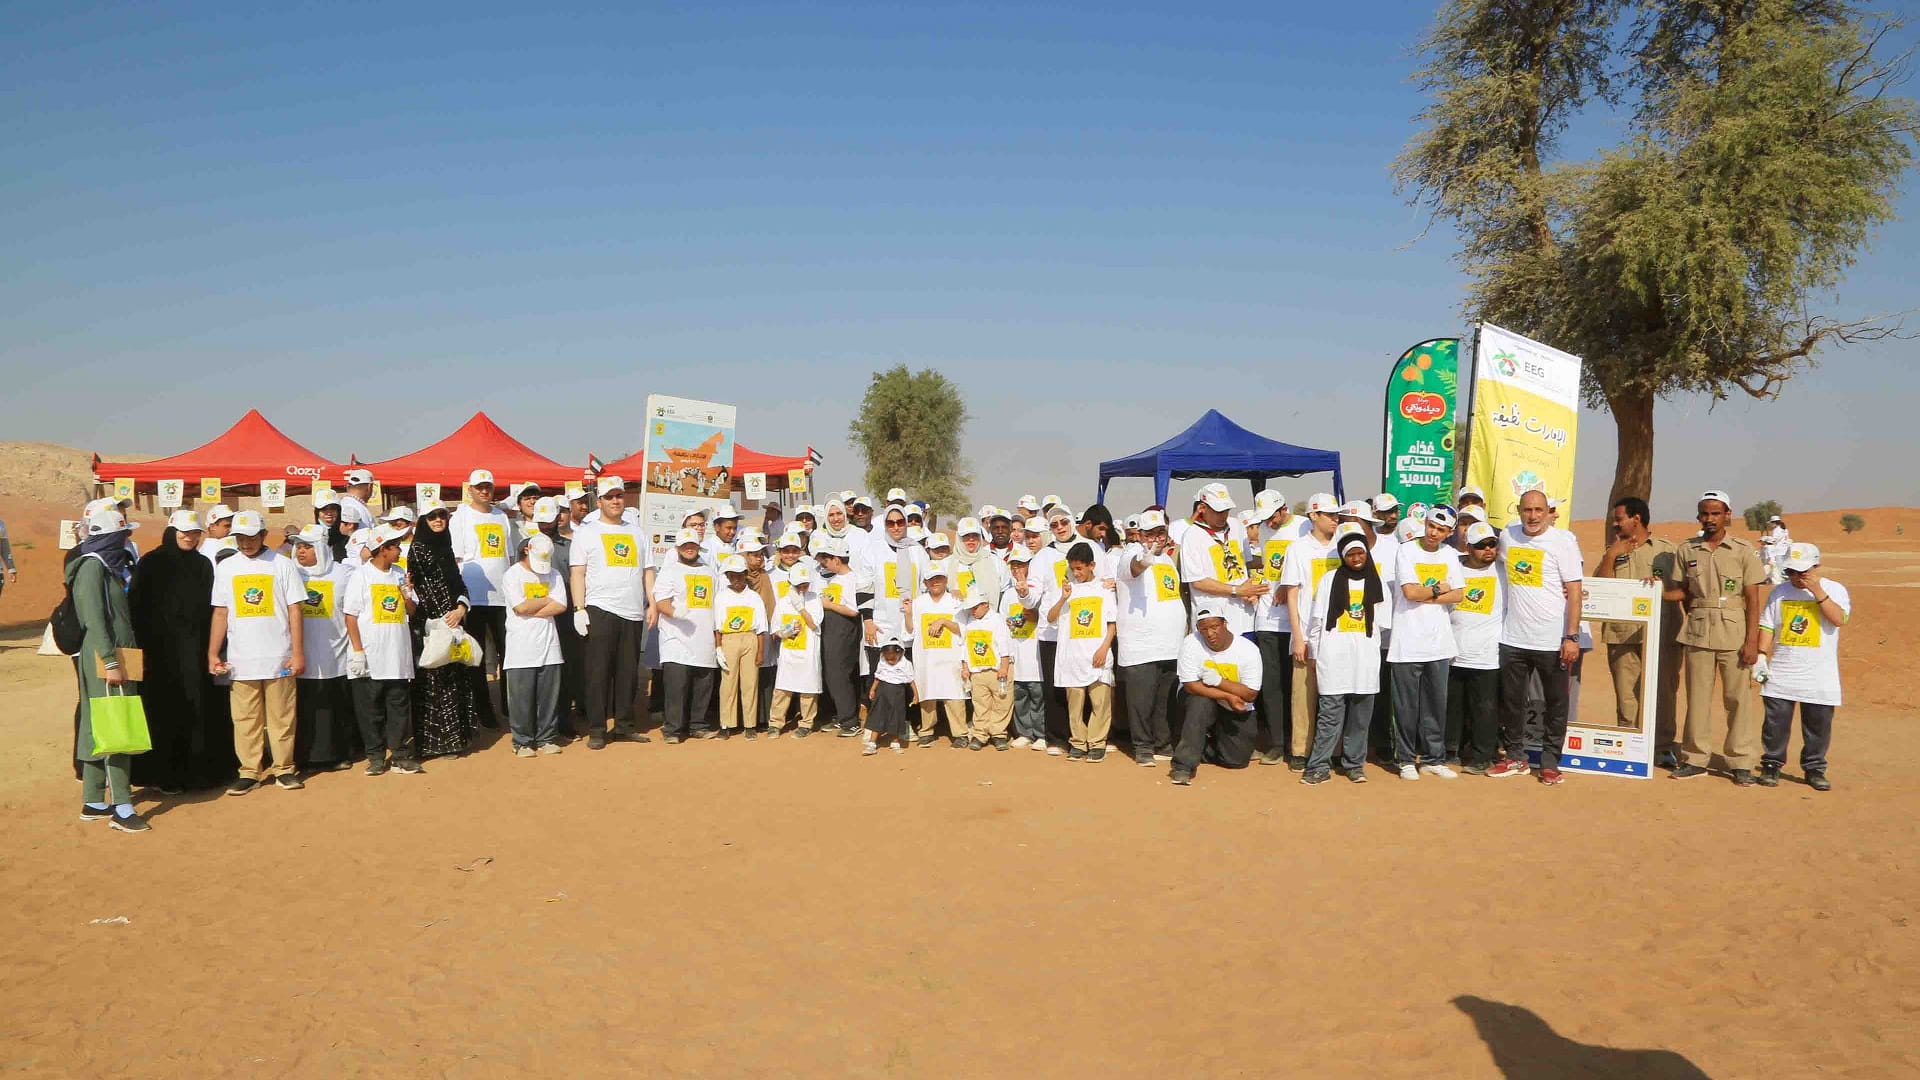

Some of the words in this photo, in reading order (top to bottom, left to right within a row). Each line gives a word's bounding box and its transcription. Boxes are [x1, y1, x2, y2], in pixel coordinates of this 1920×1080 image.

[1524, 361, 1545, 378] EEG
[1493, 404, 1520, 427] نظيفة
[1408, 440, 1435, 455] غذاء
[1402, 456, 1440, 470] صحي
[1399, 473, 1441, 489] وسعيد
